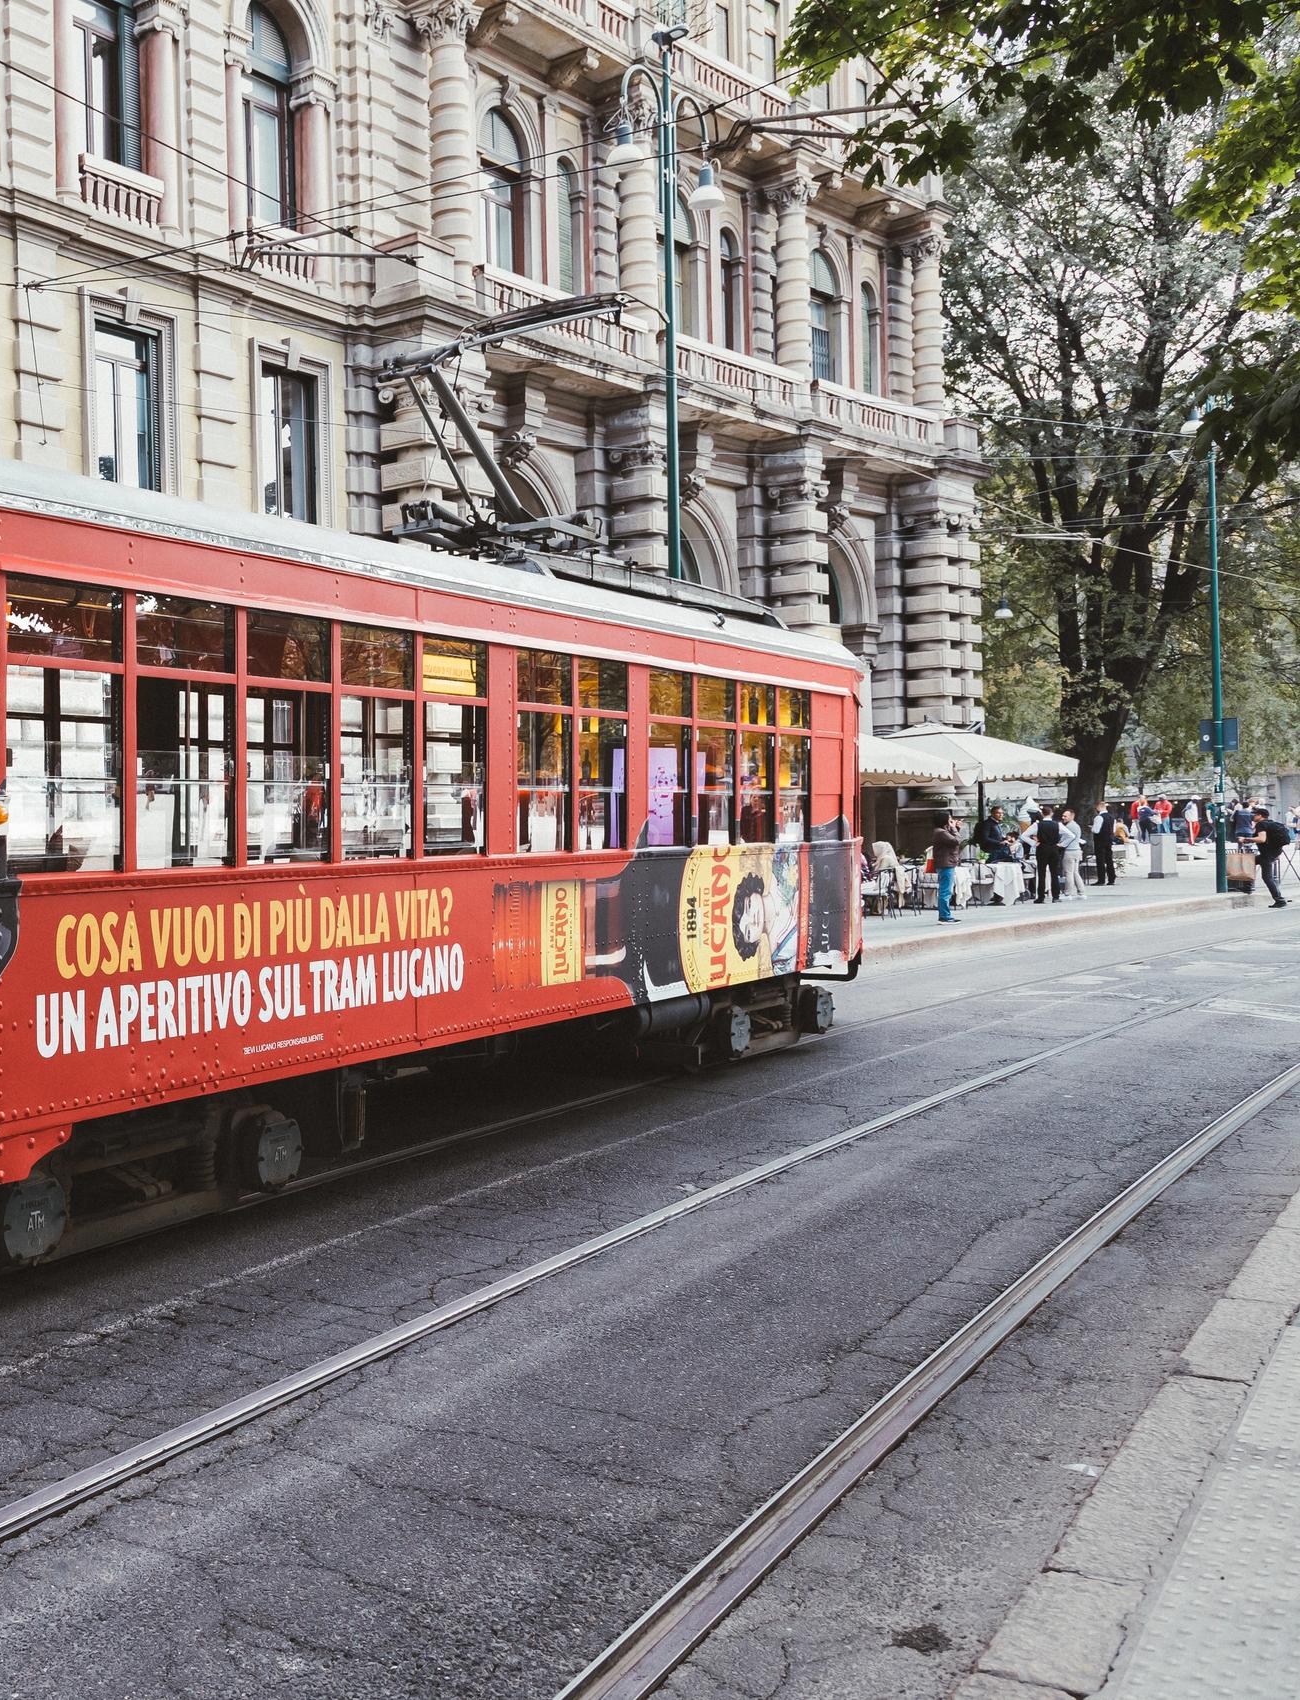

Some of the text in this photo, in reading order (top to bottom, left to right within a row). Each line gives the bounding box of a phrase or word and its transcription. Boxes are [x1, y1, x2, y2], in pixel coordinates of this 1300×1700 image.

[56, 884, 454, 979] COSA VUOI DI PIÙ DALLA VITA?
[553, 887, 569, 976] LUCANO
[686, 896, 697, 941] 1894
[702, 887, 710, 946] AMARO
[36, 942, 464, 1059] UN APERITIVO SUL TRAM LUCANO
[256, 1042, 277, 1053] LUCANO
[277, 1033, 324, 1049] RESPONSABILMENTE
[28, 1210, 45, 1232] ATM
